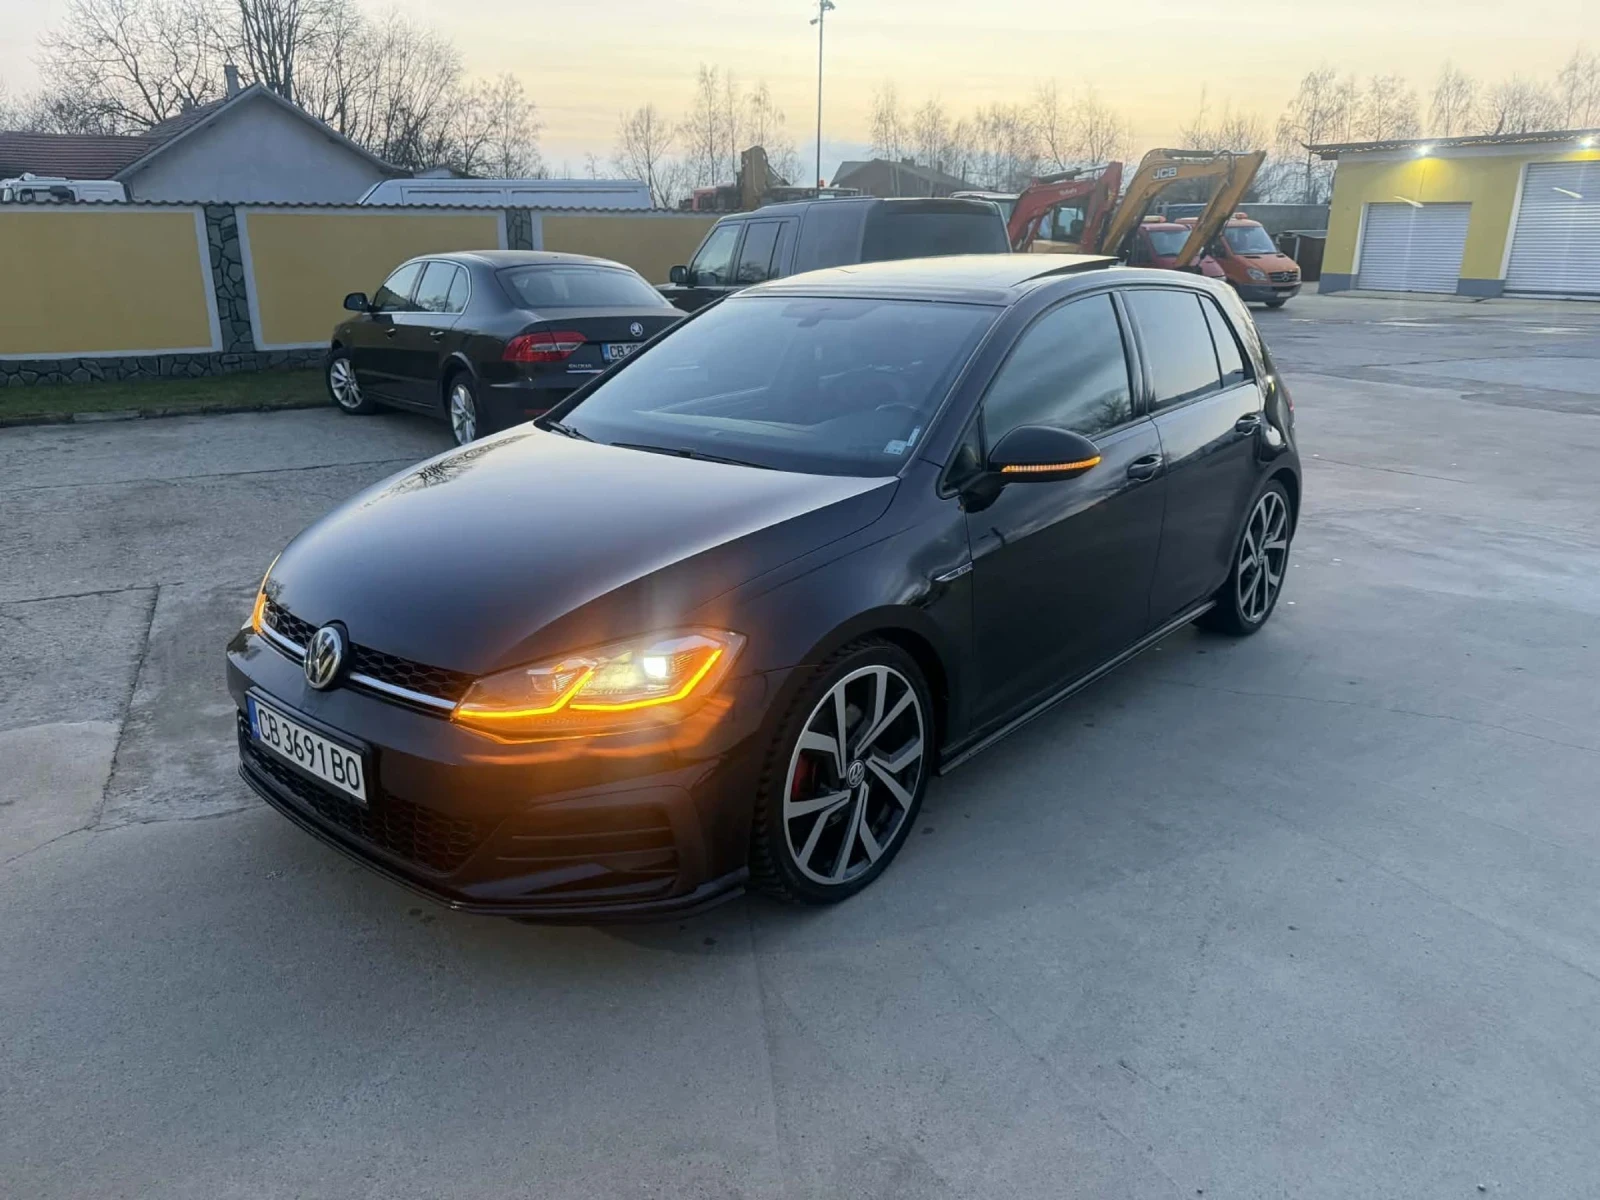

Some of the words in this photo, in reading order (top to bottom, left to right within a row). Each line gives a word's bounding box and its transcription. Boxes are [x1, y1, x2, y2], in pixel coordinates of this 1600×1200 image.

[1152, 167, 1177, 179] JCB
[610, 345, 624, 358] CB
[258, 708, 281, 747] CB
[282, 722, 327, 776] 3691
